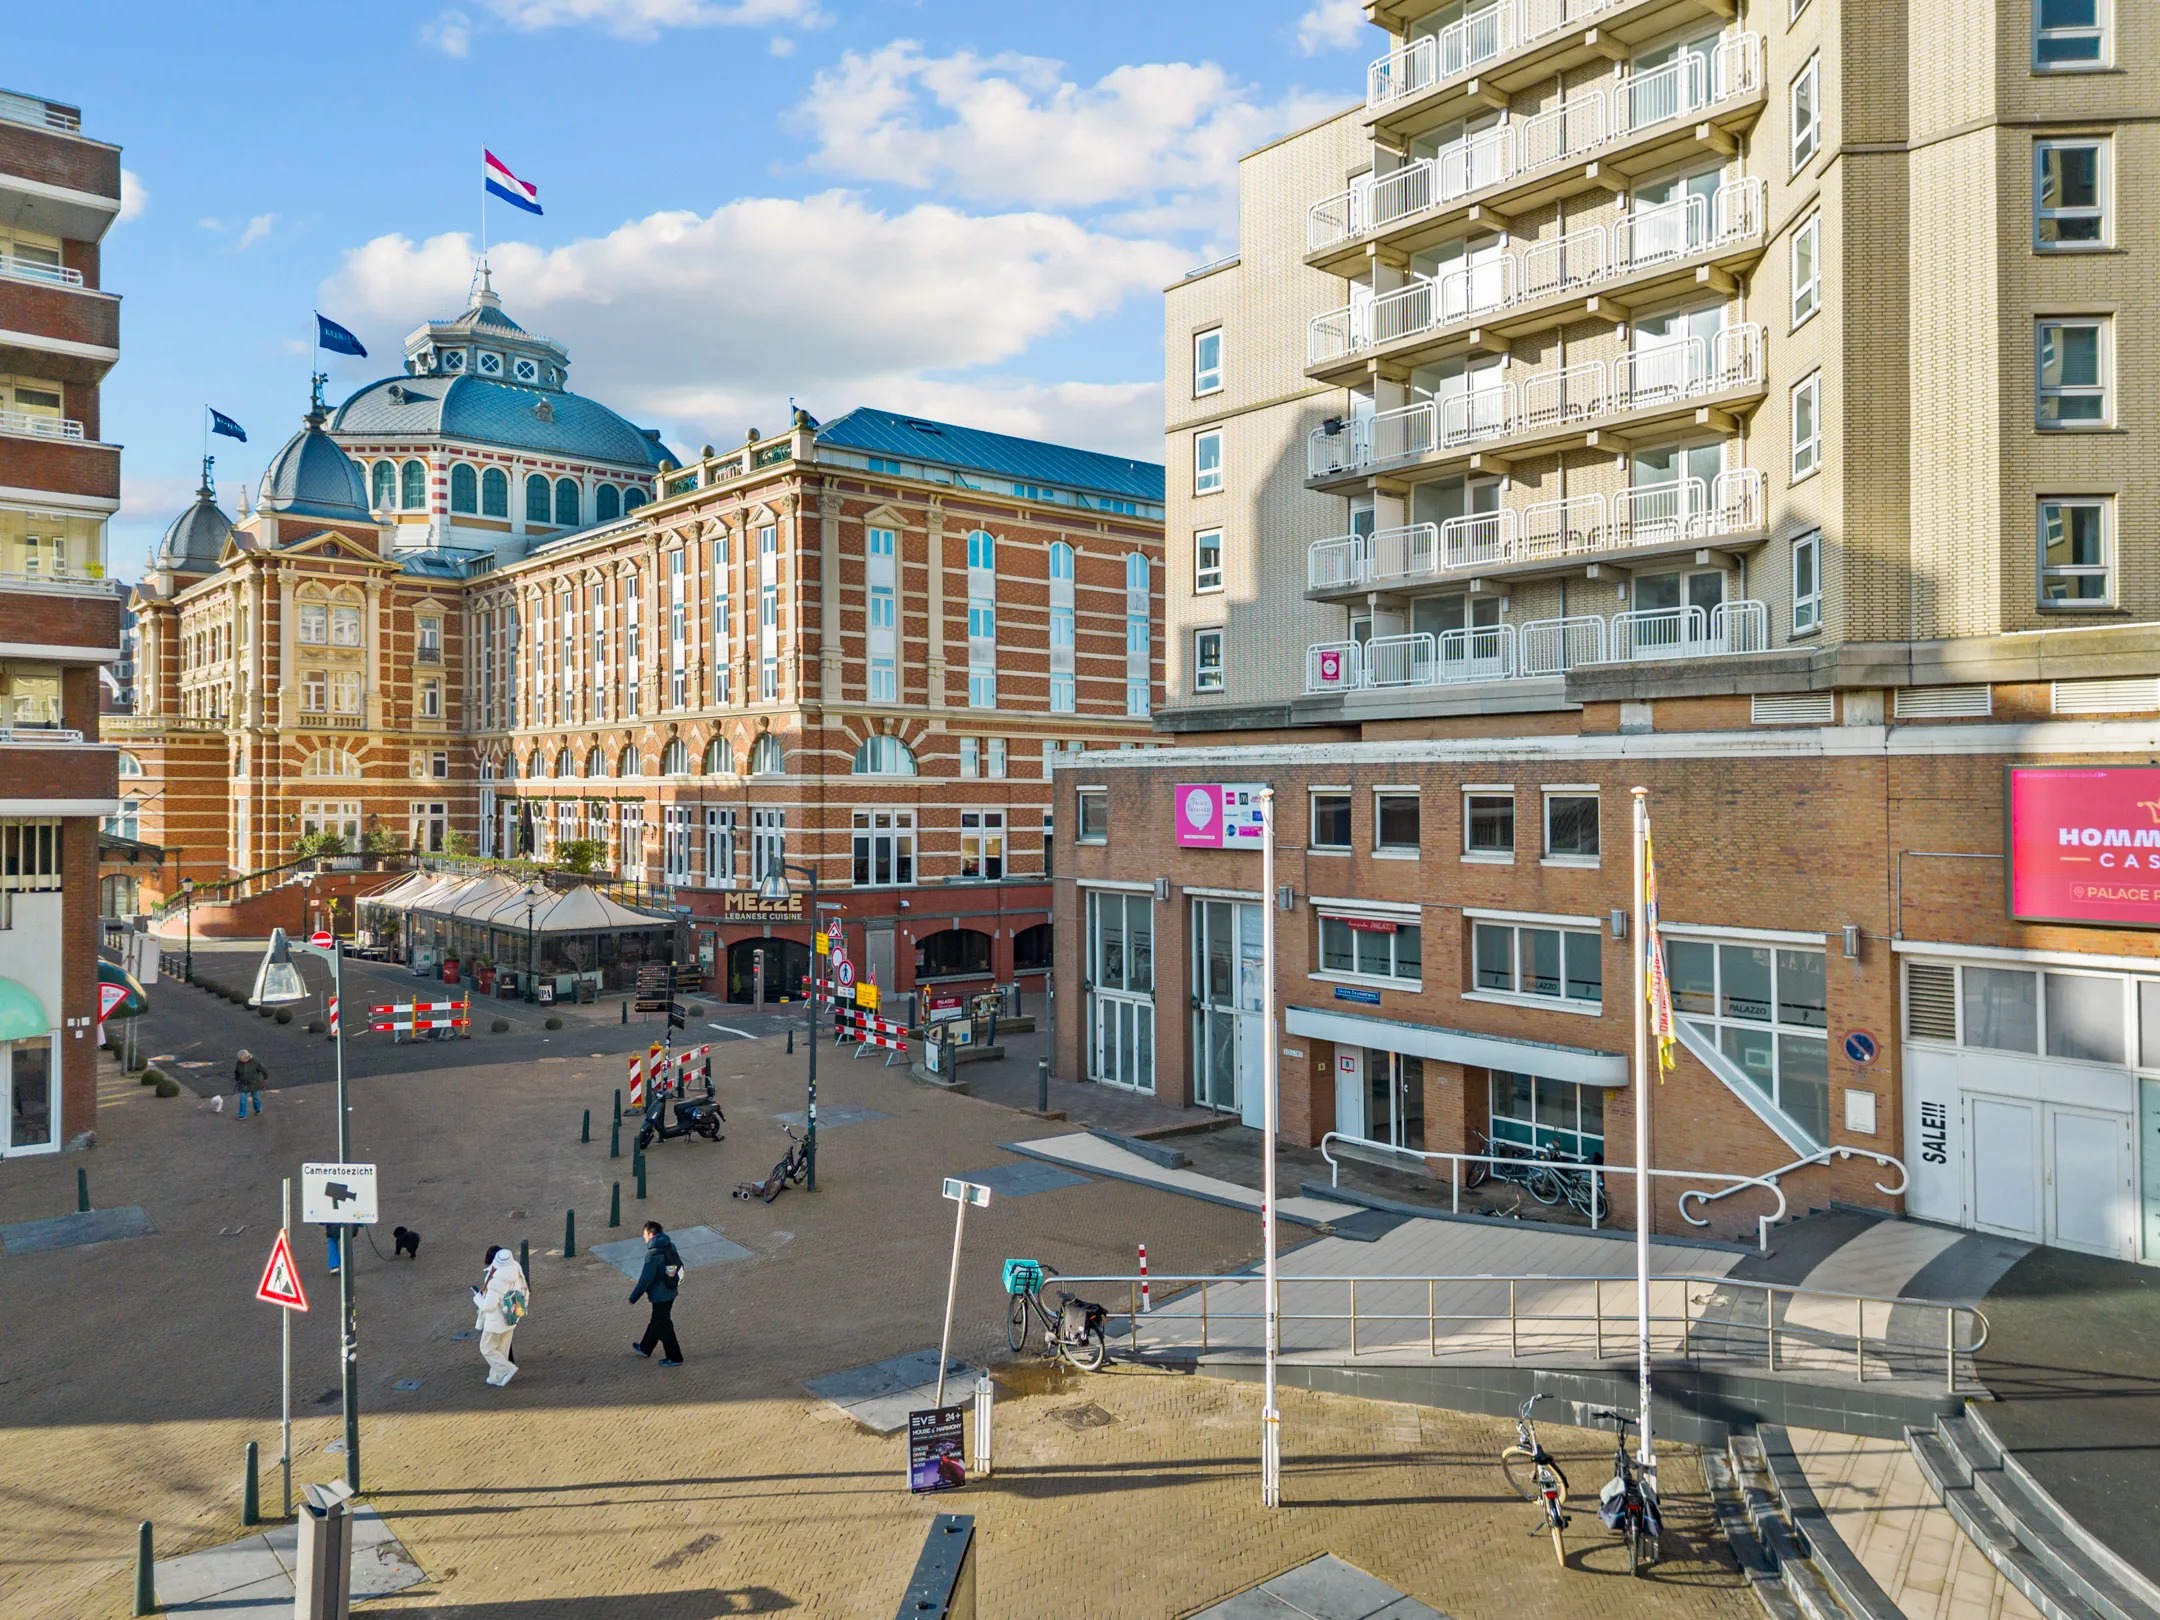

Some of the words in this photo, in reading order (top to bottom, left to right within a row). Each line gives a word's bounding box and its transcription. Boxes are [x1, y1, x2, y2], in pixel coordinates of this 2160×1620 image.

[2099, 853, 2160, 869] CAS
[2087, 887, 2149, 900] PALACE
[725, 893, 803, 912] MEZZE
[1526, 981, 1557, 991] PALAZZO
[1728, 1003, 1767, 1015] PALAZZO
[1922, 1101, 1947, 1165] SALE!!!
[304, 1166, 373, 1175] Cameratoezicht
[912, 1415, 936, 1426] EVE
[945, 1412, 961, 1422] 24+
[912, 1428, 931, 1436] HOUSE
[936, 1423, 962, 1433] HARMONY
